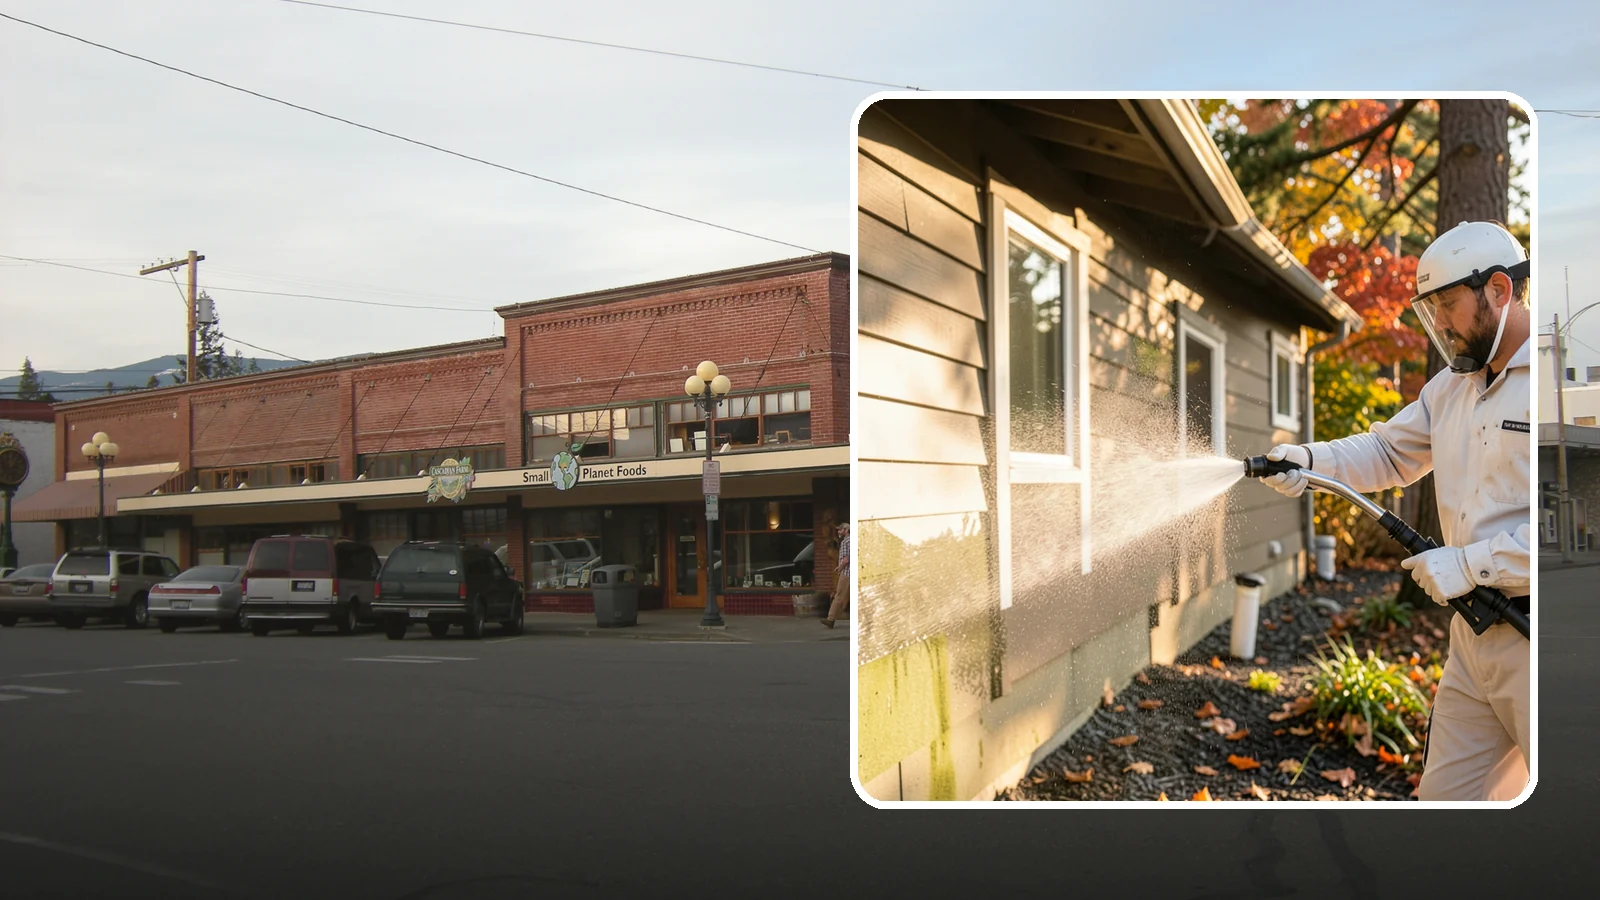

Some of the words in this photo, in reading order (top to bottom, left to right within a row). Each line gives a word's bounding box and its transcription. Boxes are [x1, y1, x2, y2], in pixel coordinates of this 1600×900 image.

[523, 470, 549, 483] Small
[582, 467, 614, 479] Planet
[616, 464, 647, 477] Foods
